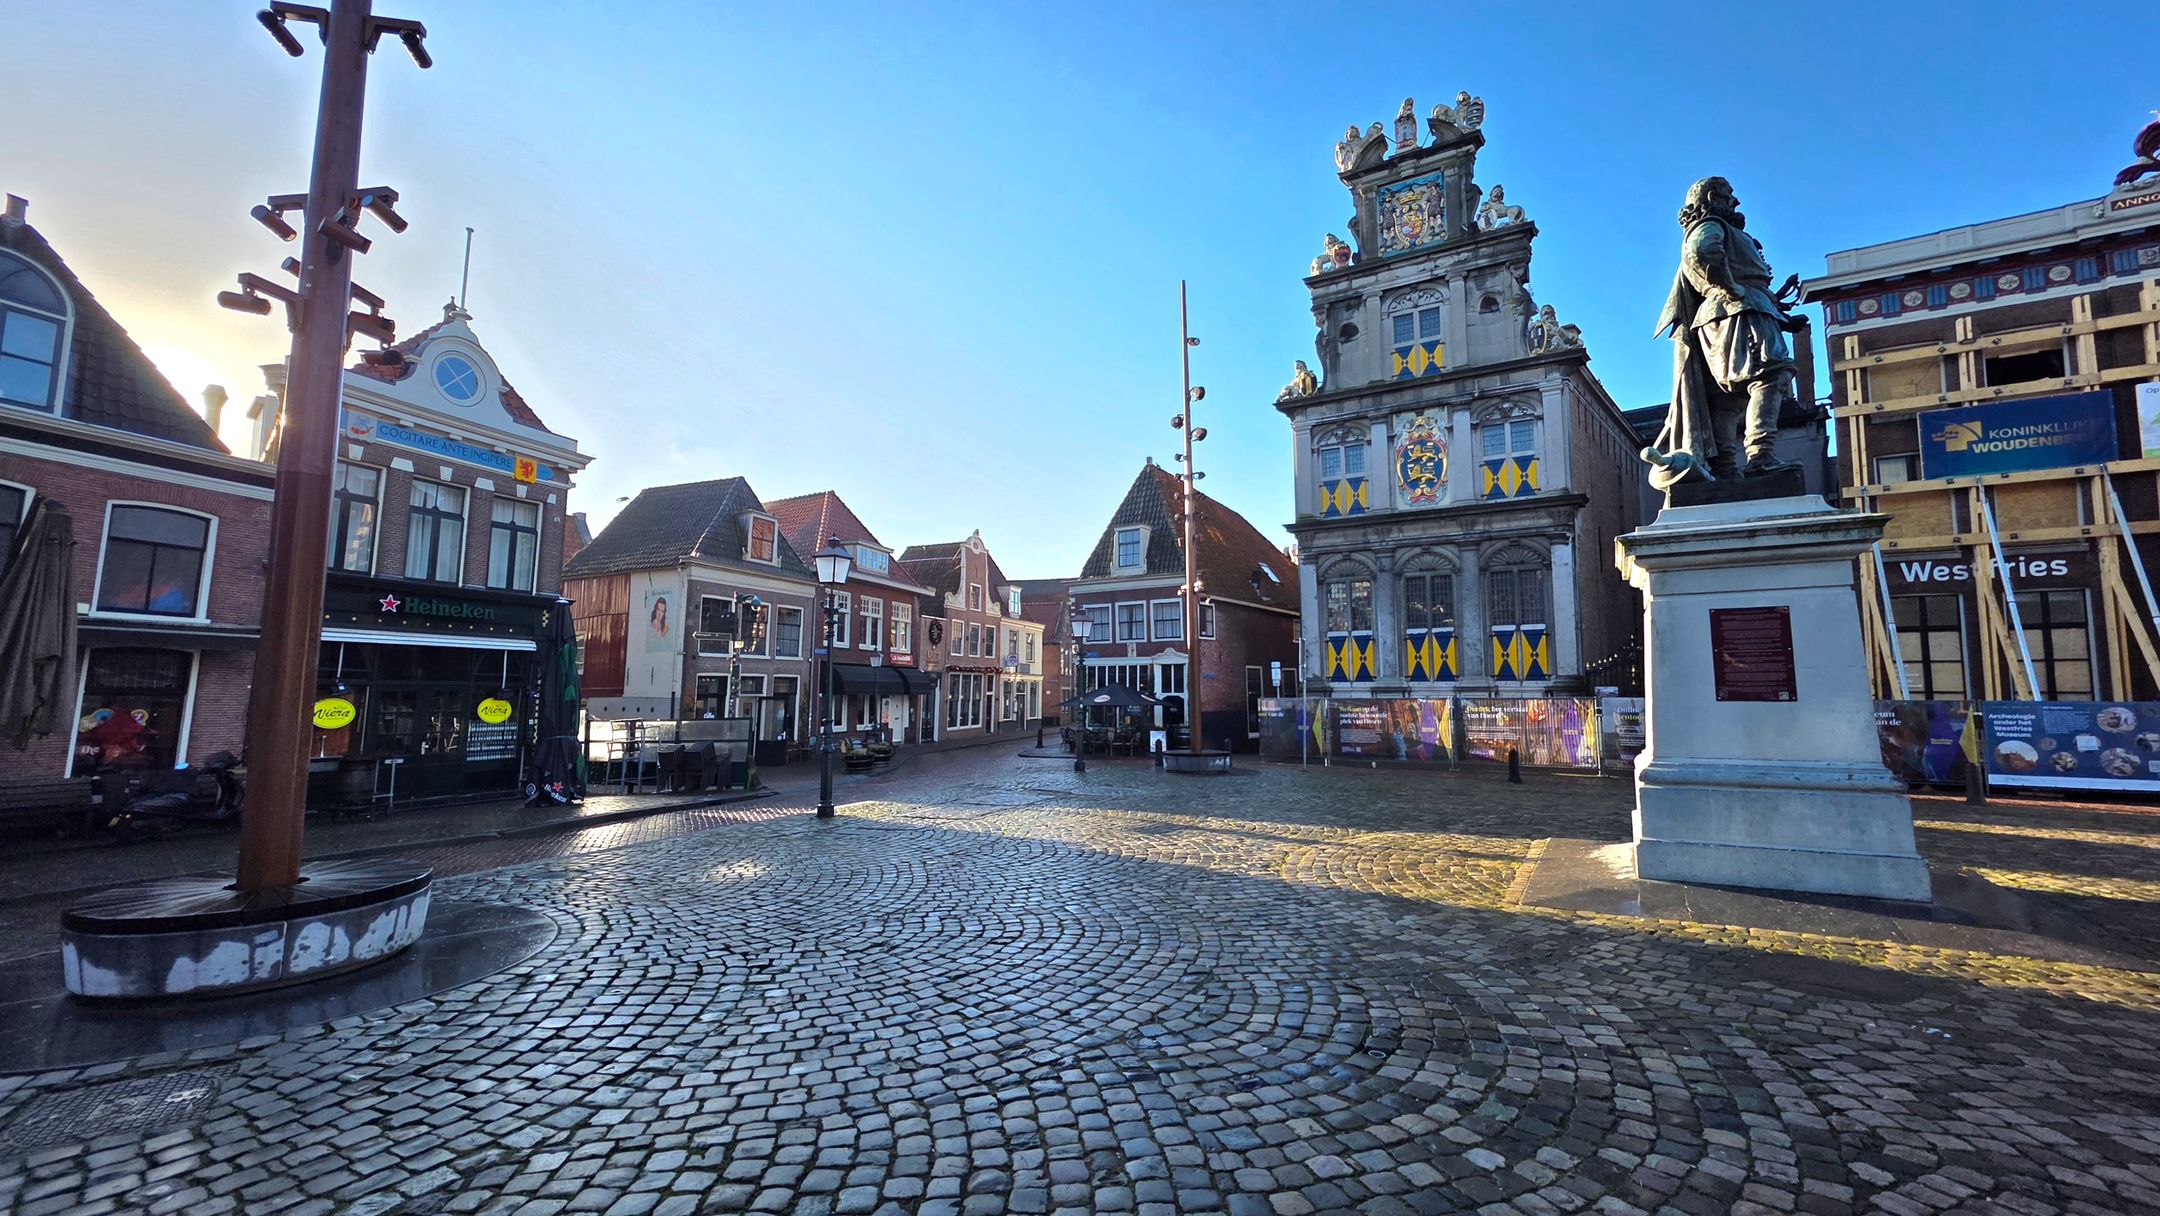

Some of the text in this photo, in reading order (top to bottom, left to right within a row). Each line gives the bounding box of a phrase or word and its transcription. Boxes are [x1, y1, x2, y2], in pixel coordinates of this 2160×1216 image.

[2115, 194, 2160, 209] ANNO
[1989, 418, 2096, 439] KONINKLIJK
[379, 425, 512, 467] COGITARE ANTE INCIPERE
[1972, 432, 2087, 453] WOUDENBE
[1900, 556, 2068, 583] Wesfries
[404, 597, 495, 619] Heineken
